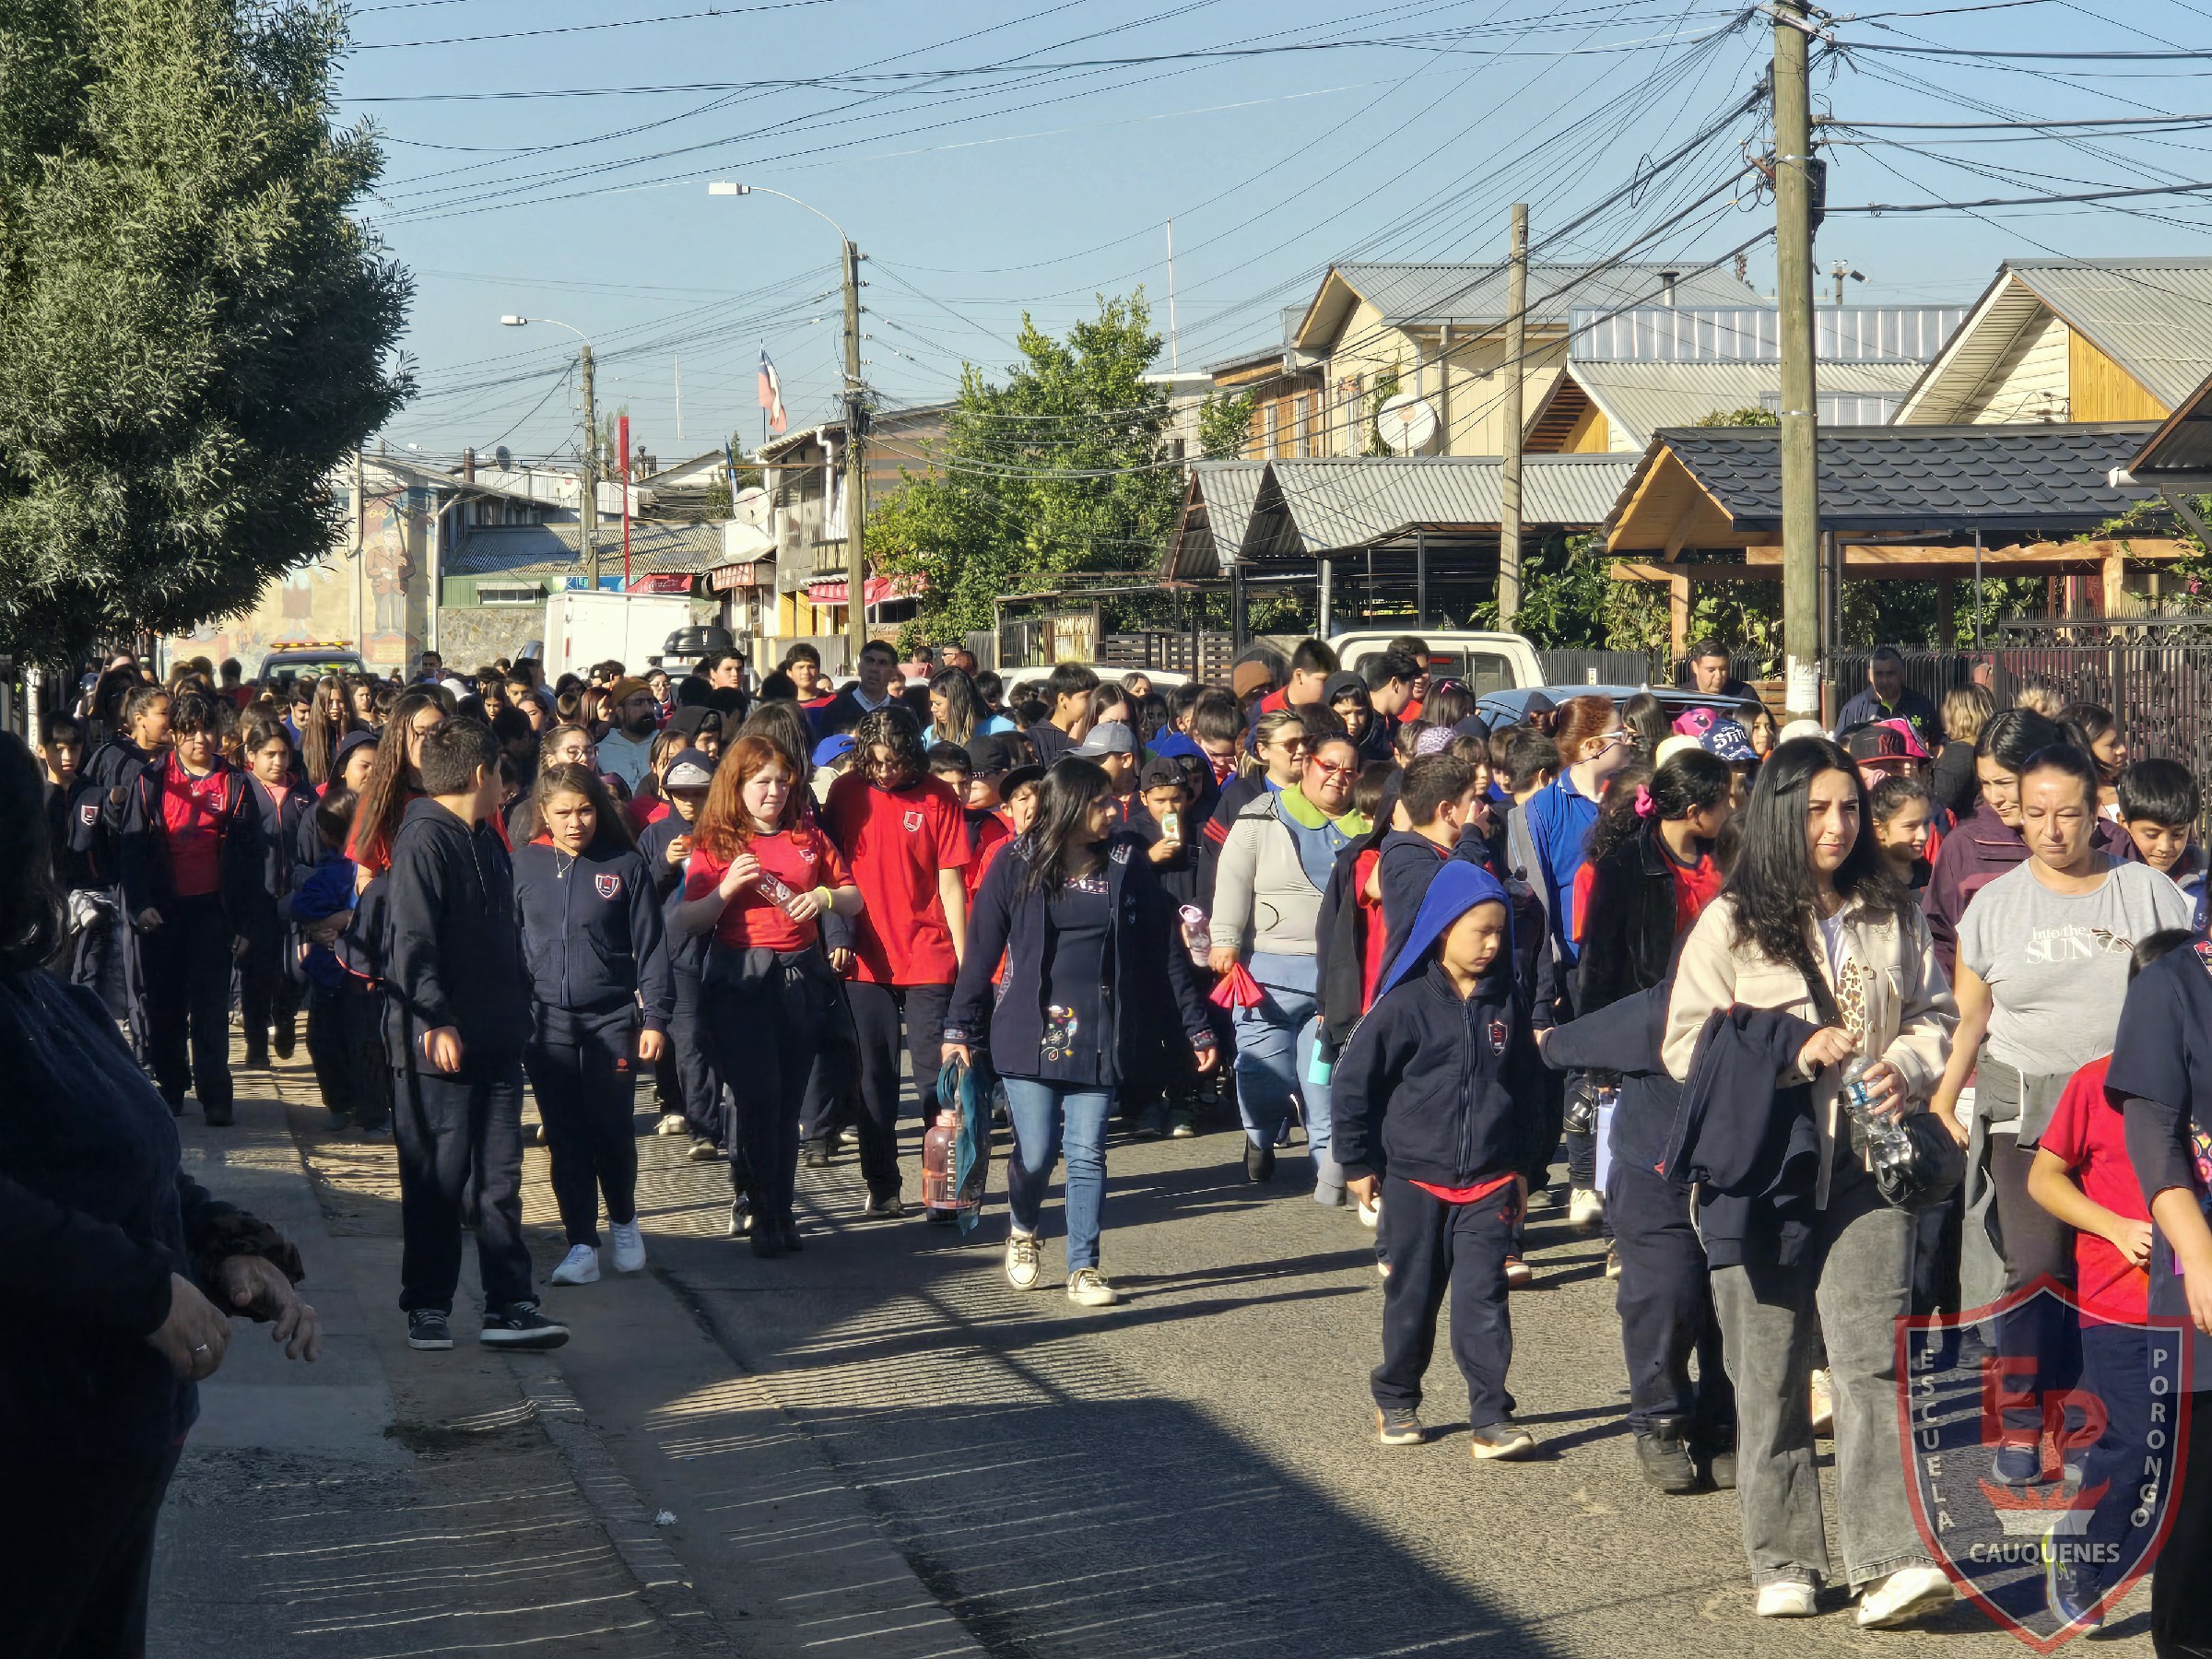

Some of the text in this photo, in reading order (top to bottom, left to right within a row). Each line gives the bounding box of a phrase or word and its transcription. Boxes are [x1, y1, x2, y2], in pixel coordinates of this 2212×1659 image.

[2032, 924, 2087, 941] Into the
[2026, 933, 2093, 965] SUN
